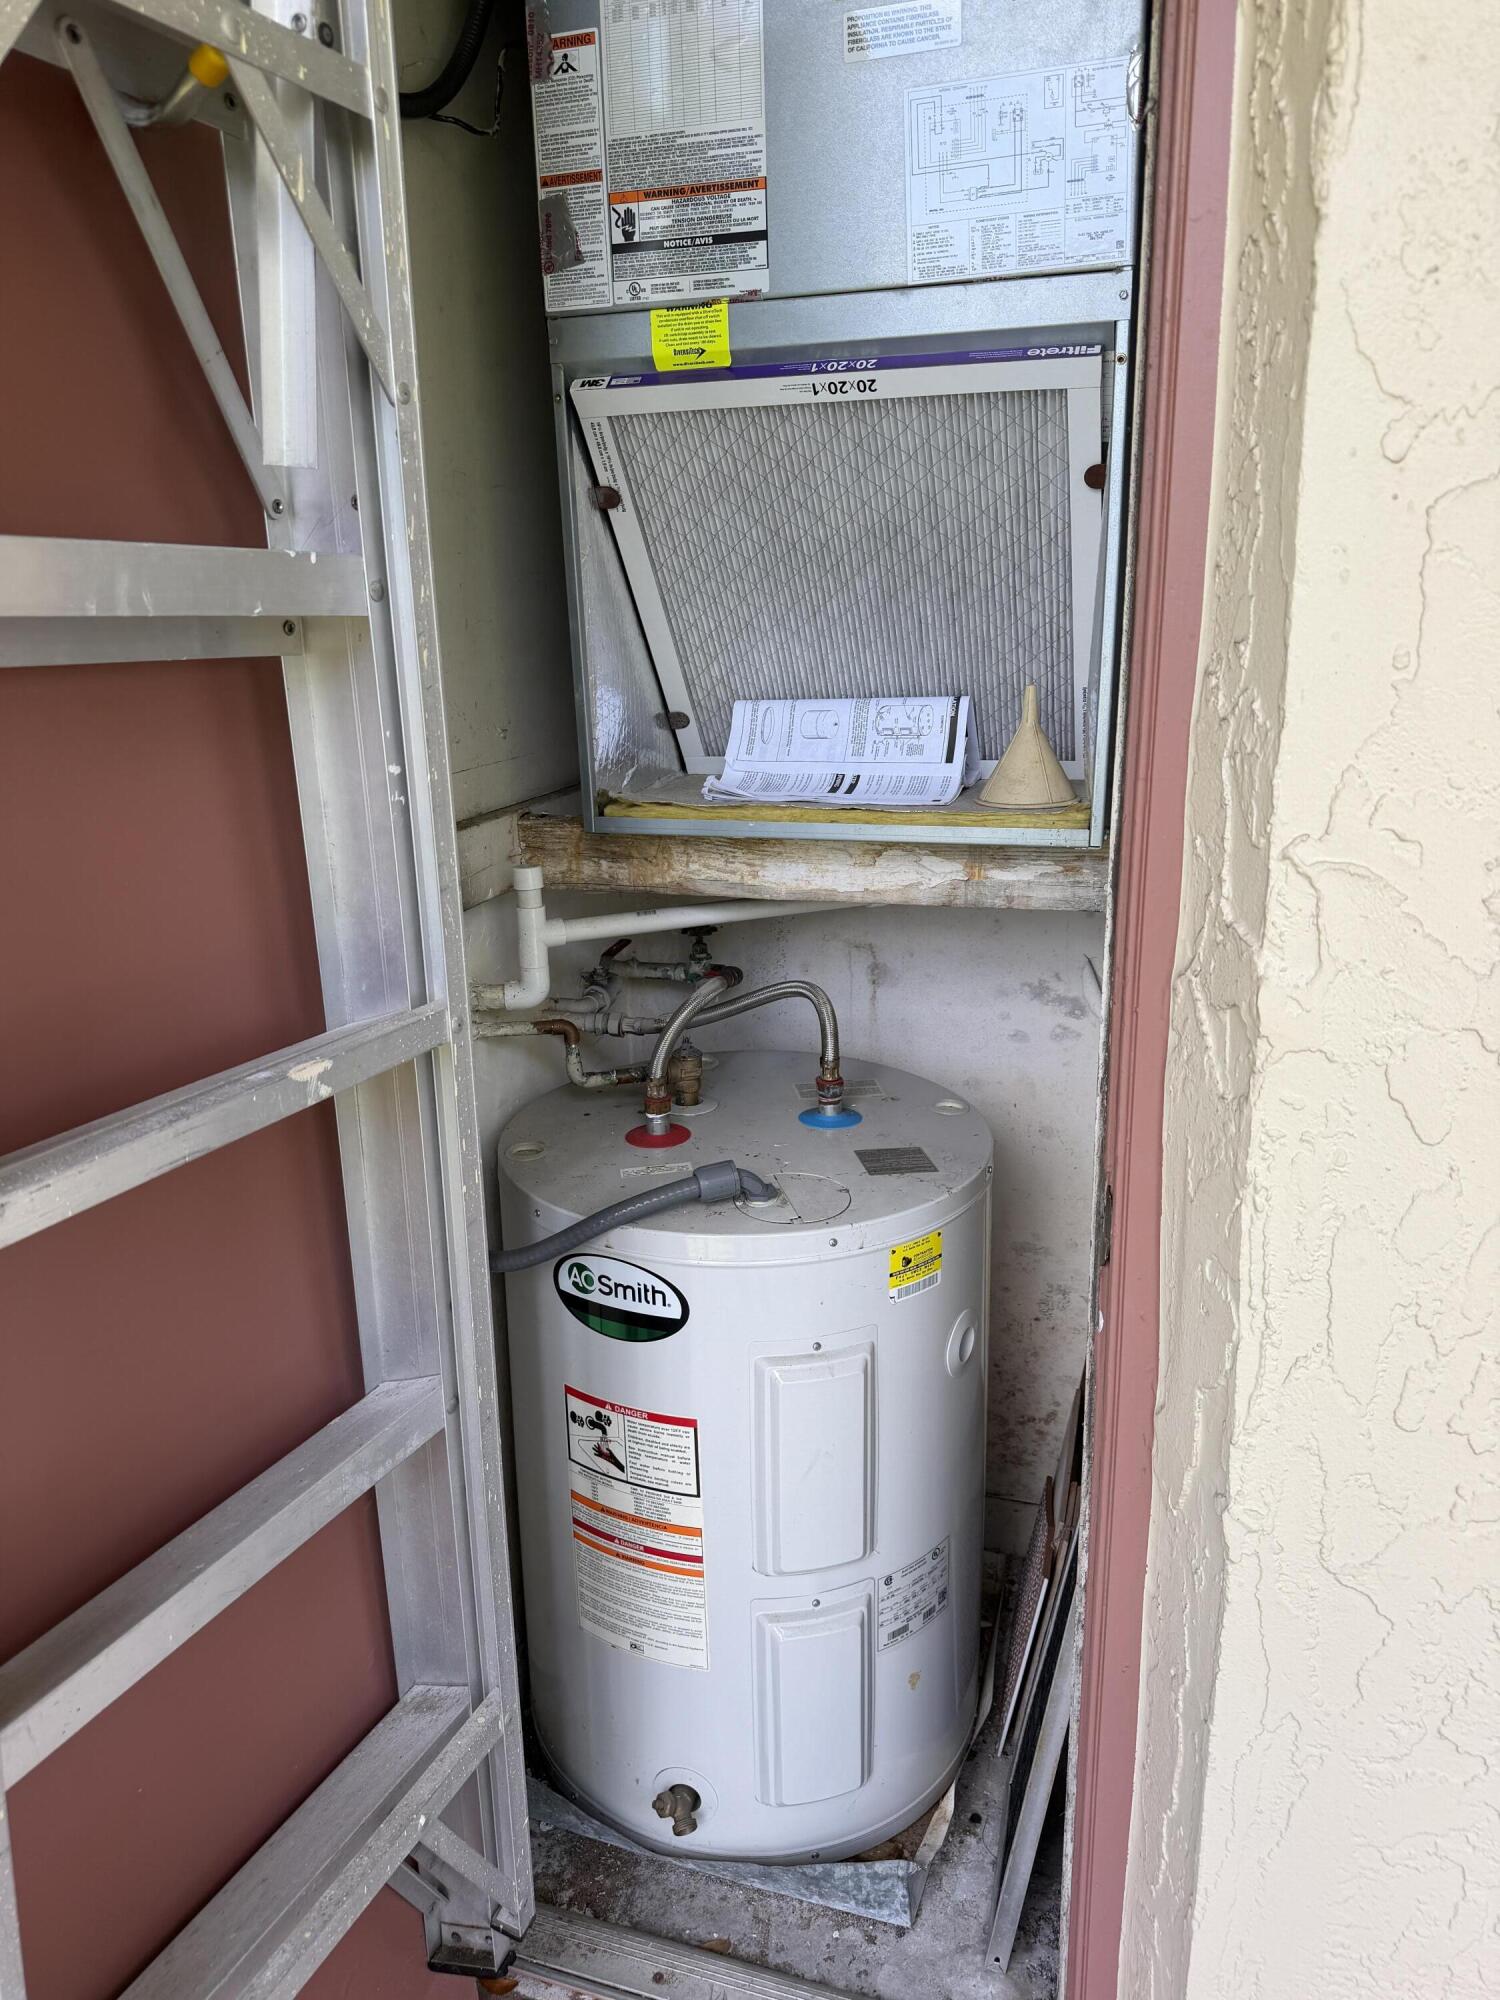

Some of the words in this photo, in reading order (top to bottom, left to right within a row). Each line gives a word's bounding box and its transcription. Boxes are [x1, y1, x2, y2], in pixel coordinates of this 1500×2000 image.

[847, 20, 877, 30] APPLIANCE
[893, 30, 913, 38] KNOWN
[552, 33, 591, 50] ARNING
[856, 42, 888, 52] CALIFORNIA
[672, 196, 706, 204] HAZARDOUS
[664, 237, 713, 248] NOTICE/AVIS
[1027, 345, 1101, 356] Filtrete
[580, 379, 605, 387] 3M
[598, 1274, 667, 1307] Smith
[614, 1406, 648, 1419] DANGER
